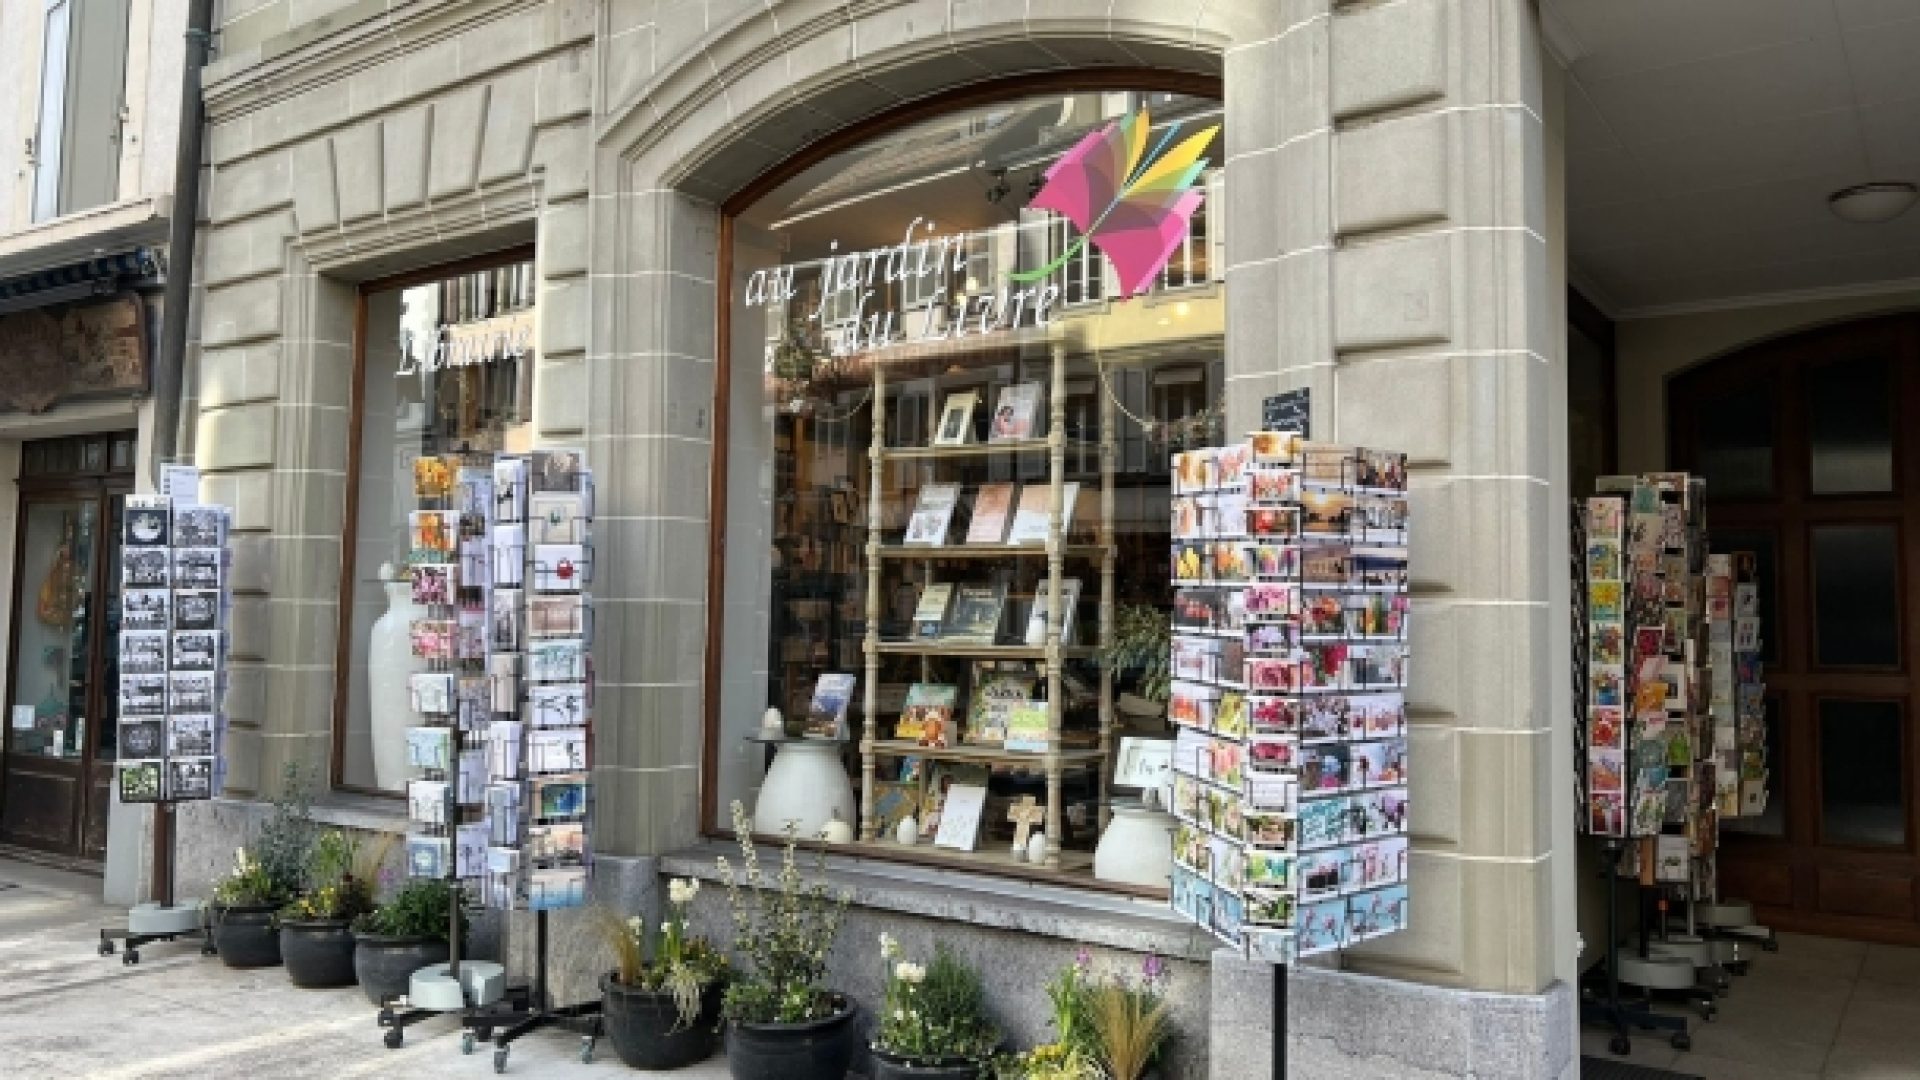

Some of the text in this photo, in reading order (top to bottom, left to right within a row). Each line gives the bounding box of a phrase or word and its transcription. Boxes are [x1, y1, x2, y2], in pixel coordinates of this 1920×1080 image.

[745, 216, 968, 320] au jardin
[832, 289, 894, 354] du
